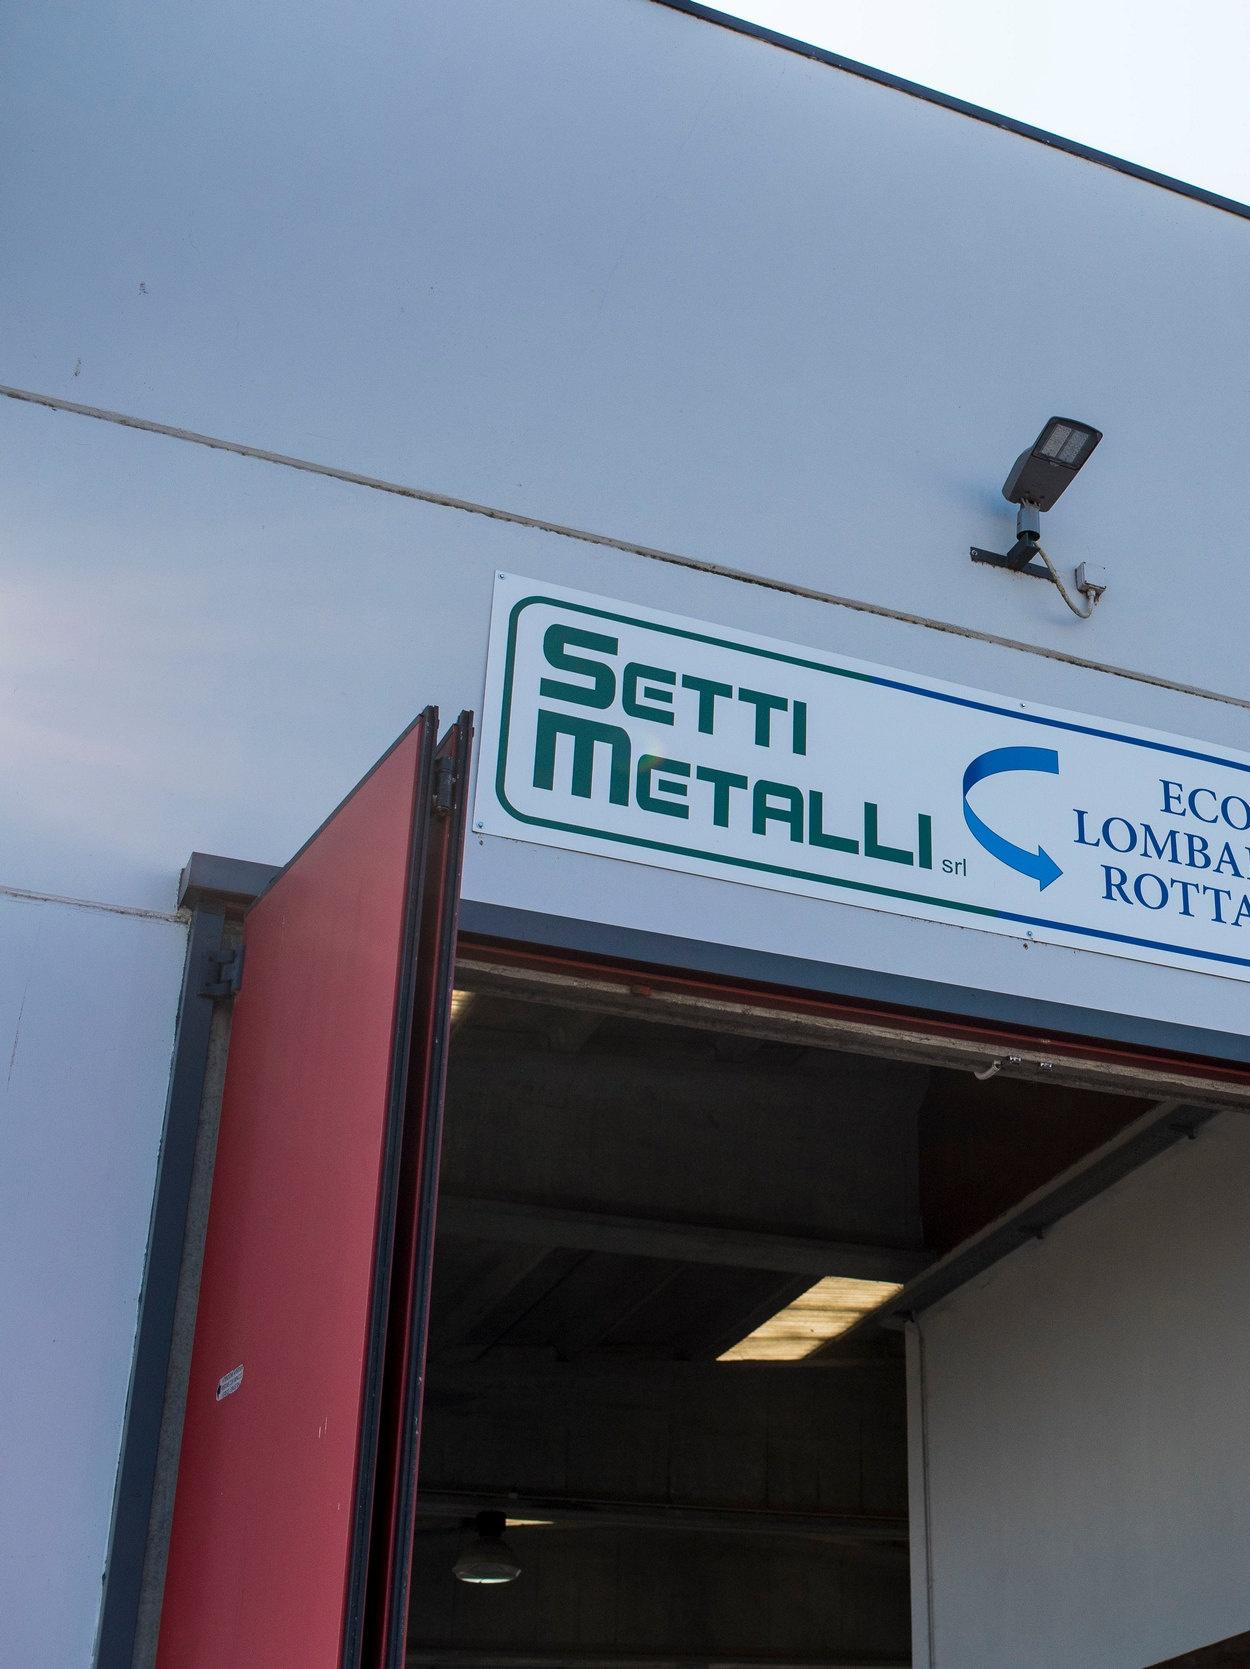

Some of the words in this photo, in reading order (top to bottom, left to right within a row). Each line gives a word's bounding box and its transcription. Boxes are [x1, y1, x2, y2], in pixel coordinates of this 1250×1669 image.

[540, 623, 808, 757] SETTI
[533, 708, 933, 871] METALLI
[942, 858, 967, 877] srl
